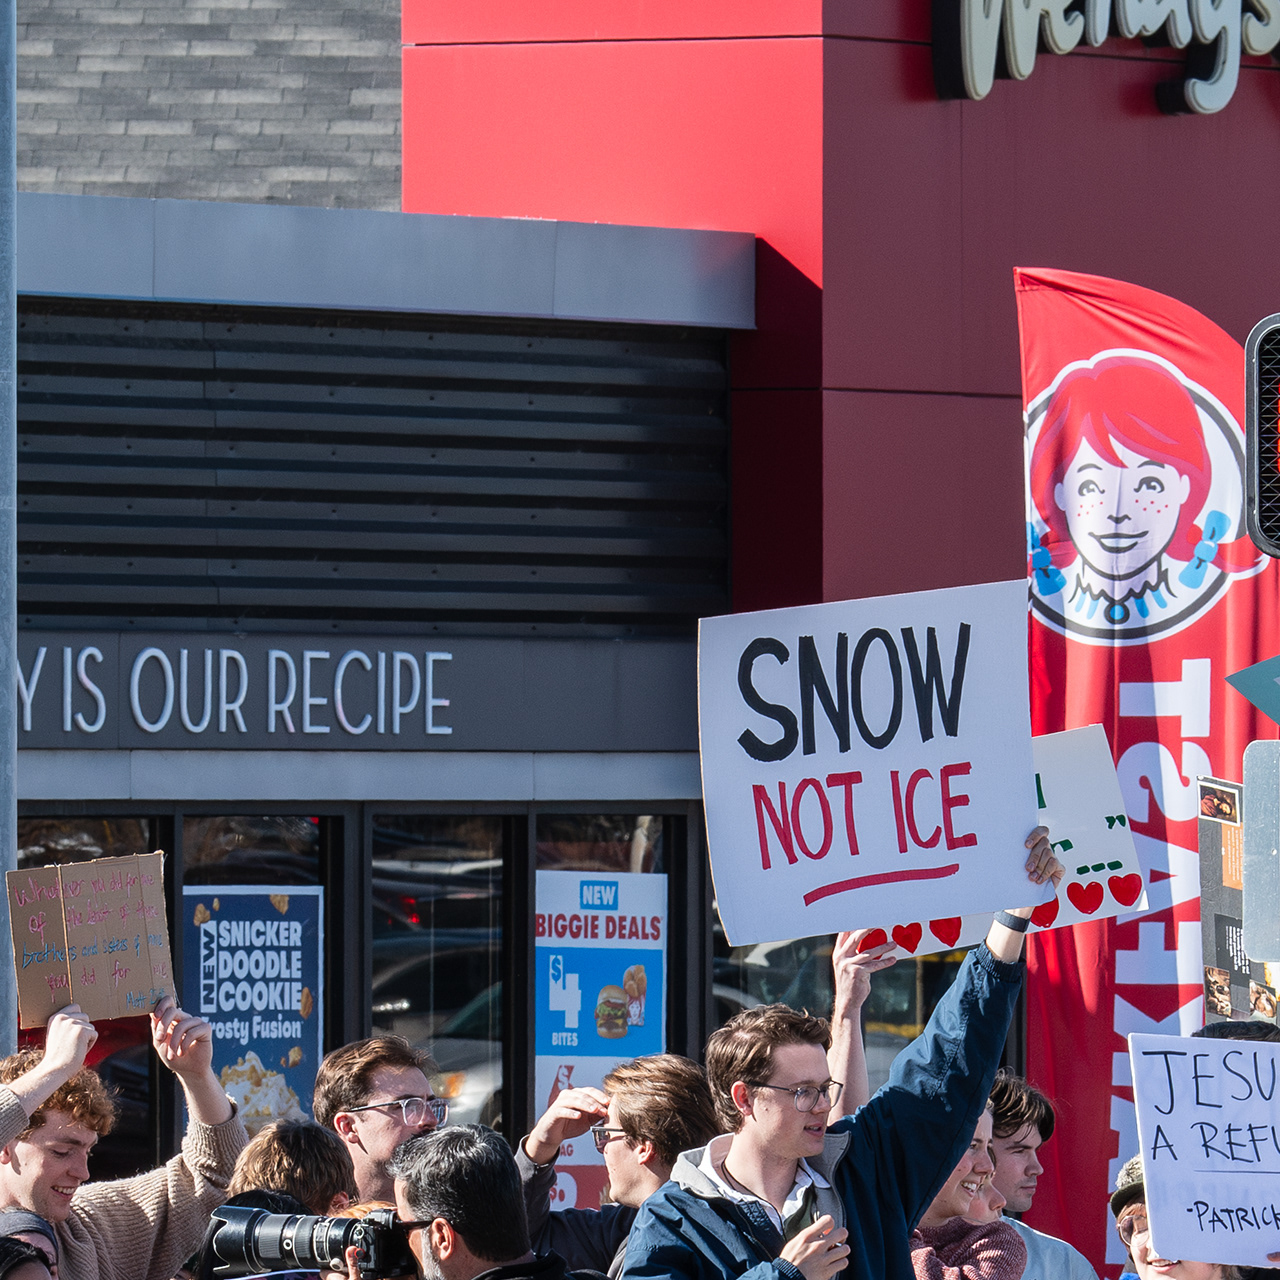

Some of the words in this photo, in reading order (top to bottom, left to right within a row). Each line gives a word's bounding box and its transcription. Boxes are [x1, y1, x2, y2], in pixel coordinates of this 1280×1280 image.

[62, 646, 107, 734] IS
[129, 647, 248, 734] OUR
[267, 649, 453, 735] RECIPE
[737, 622, 971, 762] SNOW
[752, 770, 862, 870] NOT
[890, 761, 978, 850] ICE
[109, 871, 123, 893] did
[582, 885, 616, 906] NEW
[29, 911, 47, 946] of
[218, 919, 303, 948] SNICKER
[535, 913, 600, 939] BIGGIE
[605, 915, 662, 941] DEALS
[82, 936, 98, 957] and
[80, 965, 96, 986] did
[111, 959, 131, 989] for
[202, 927, 216, 1006] NEW
[218, 949, 303, 980] DOODLE
[218, 980, 303, 1013] COOKIE
[252, 1013, 303, 1039] Fusion
[551, 1032, 579, 1047] BITES
[559, 1144, 574, 1157] AG
[1151, 1124, 1179, 1160] A
